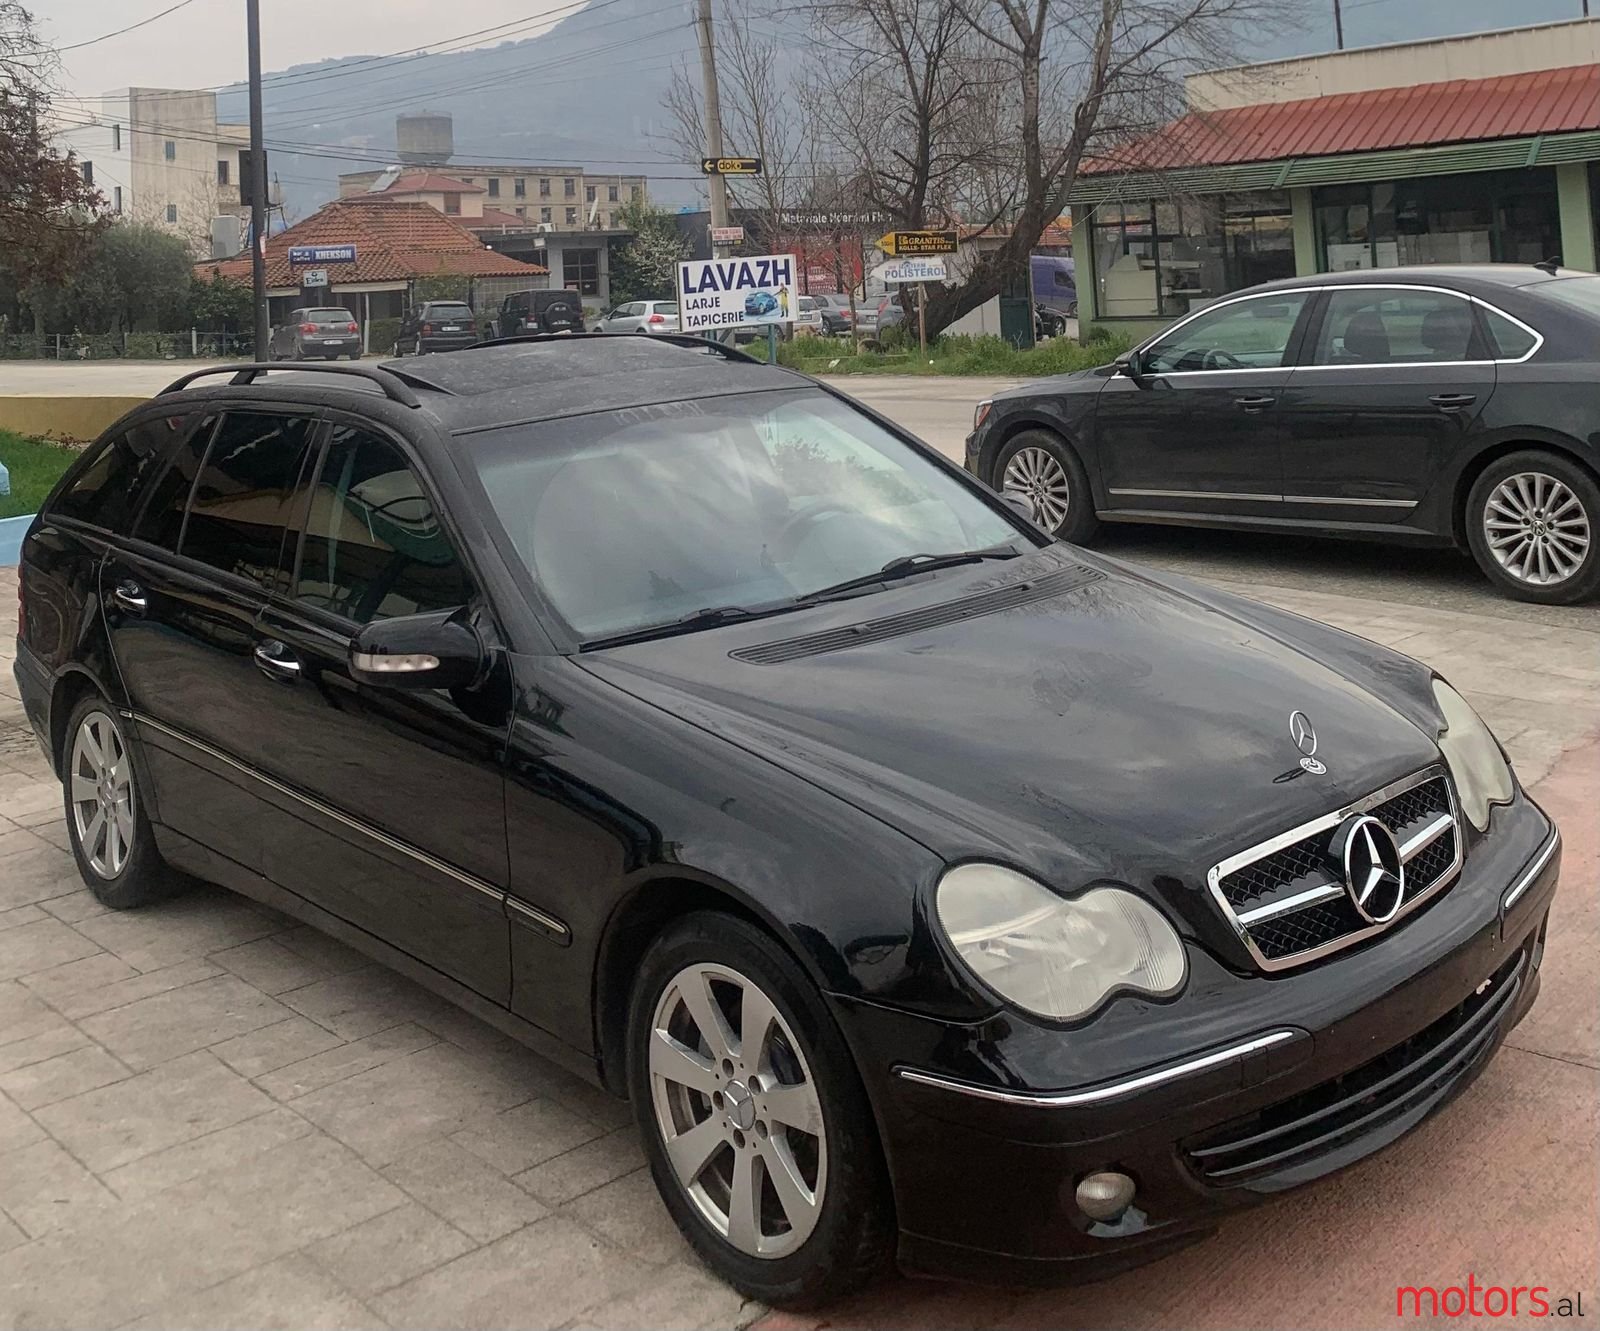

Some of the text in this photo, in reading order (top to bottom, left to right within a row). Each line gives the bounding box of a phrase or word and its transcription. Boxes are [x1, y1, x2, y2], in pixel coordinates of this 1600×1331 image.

[682, 258, 791, 294] LAVAZH
[884, 266, 946, 279] POLISTEROL
[686, 296, 721, 310] LARJE
[686, 311, 744, 327] TAPICERIE
